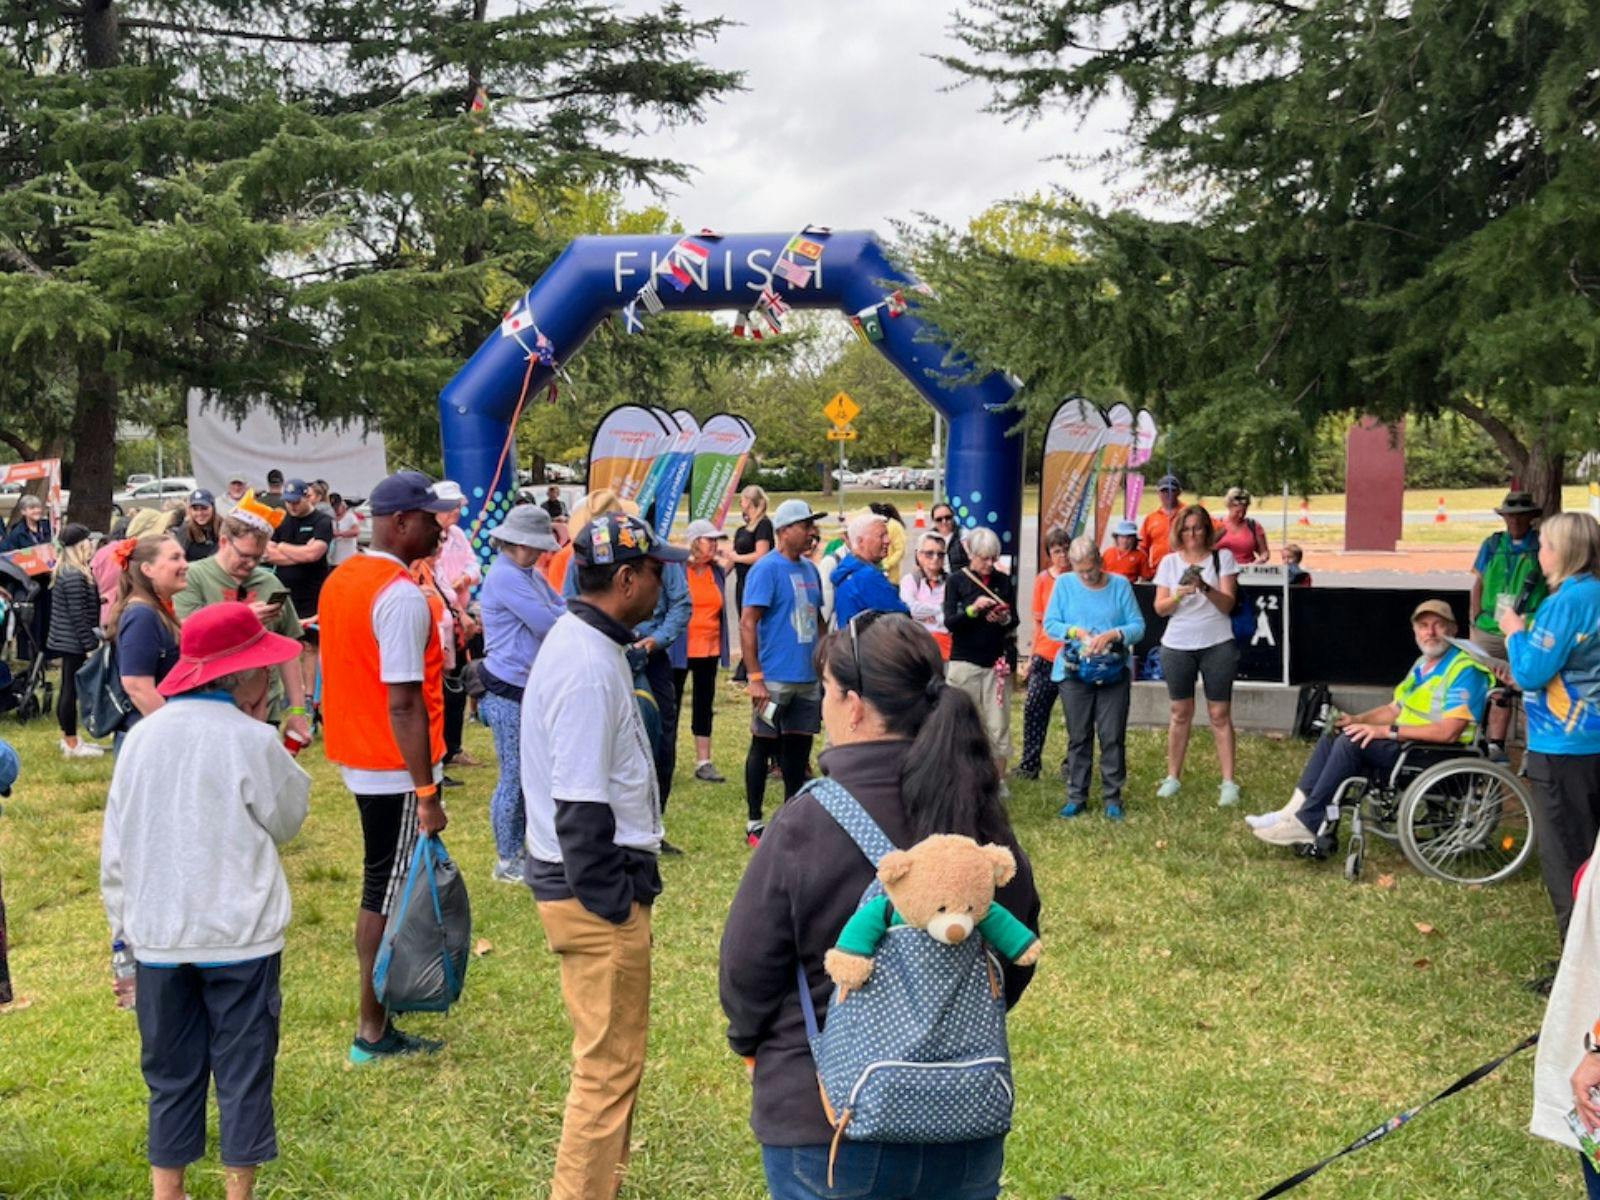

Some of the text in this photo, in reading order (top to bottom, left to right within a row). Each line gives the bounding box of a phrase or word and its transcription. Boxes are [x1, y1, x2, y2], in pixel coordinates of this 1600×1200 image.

[614, 249, 822, 292] FINISH
[695, 461, 722, 517] COMMUNITY
[1256, 595, 1279, 610] 42
